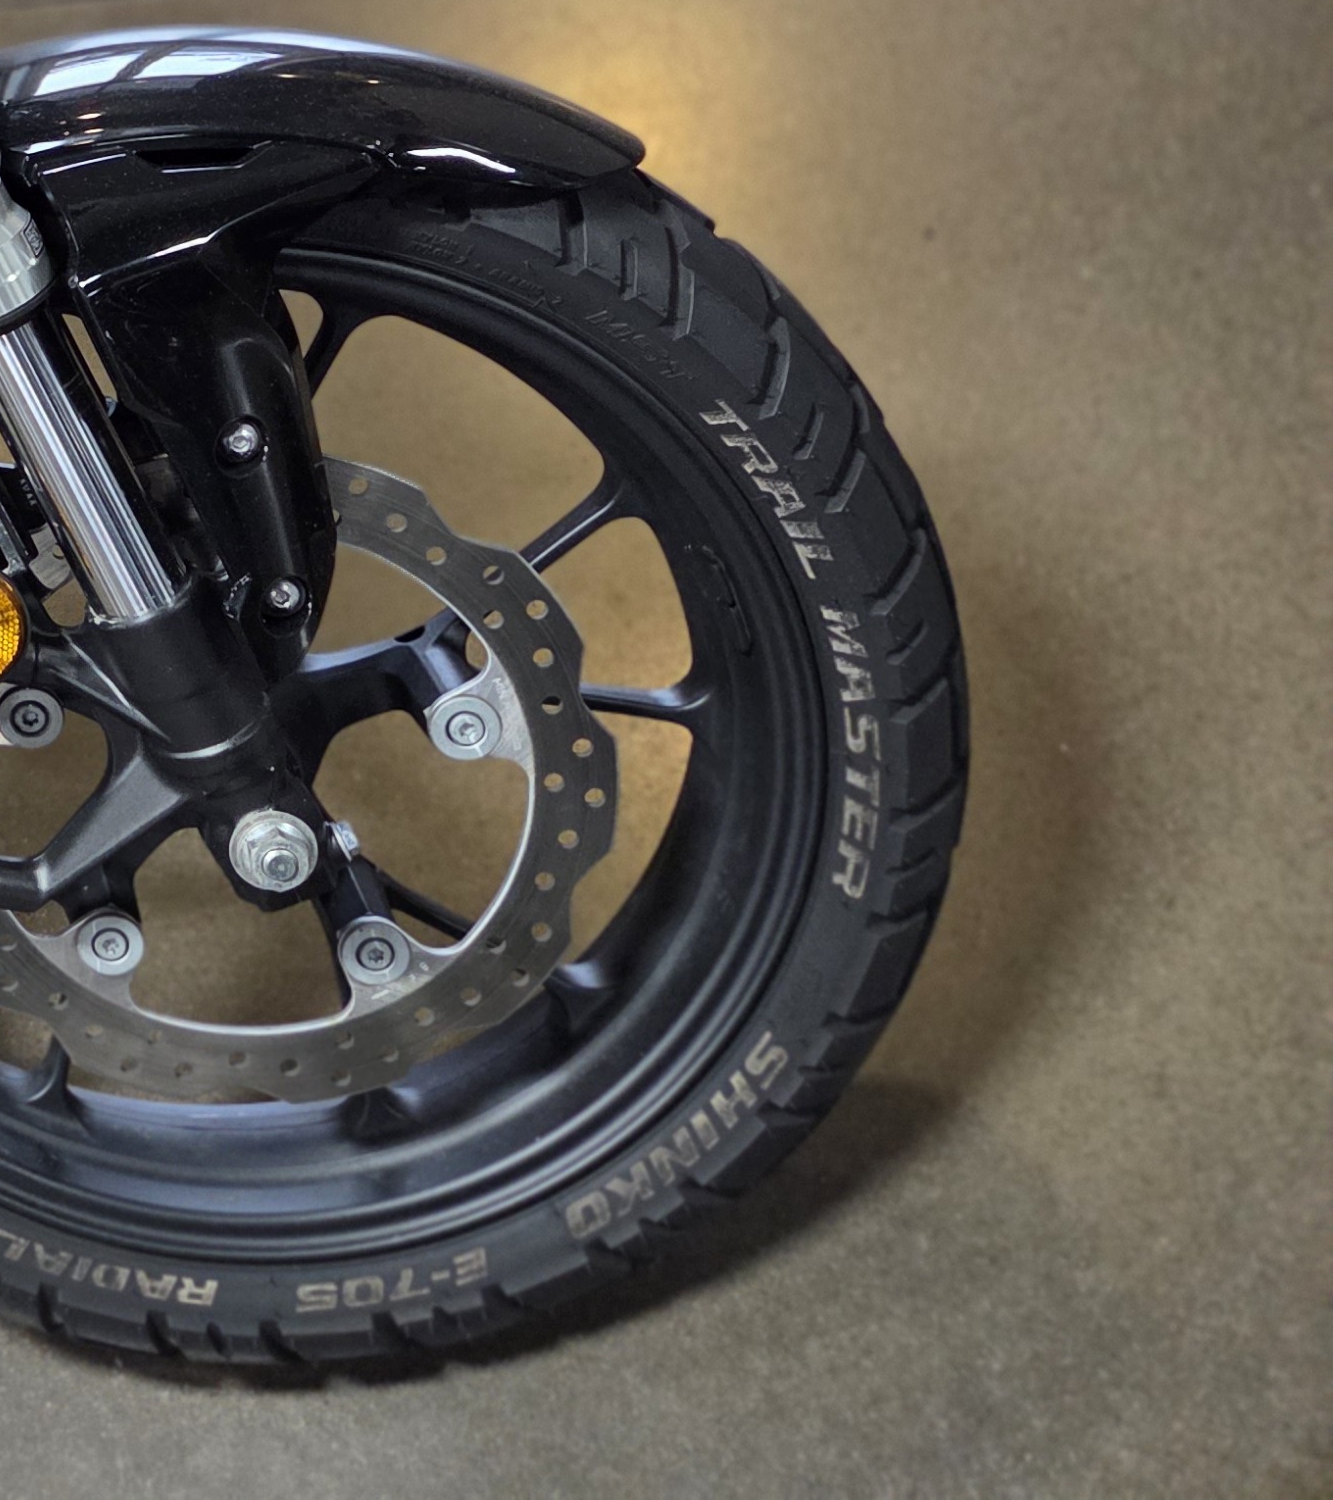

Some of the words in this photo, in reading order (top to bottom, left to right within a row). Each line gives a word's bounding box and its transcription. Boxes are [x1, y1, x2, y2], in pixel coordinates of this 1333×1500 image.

[699, 400, 833, 580] TRAIL
[820, 605, 882, 899] MASTER
[565, 1030, 788, 1239] SHINKO
[296, 1246, 488, 1313] E-705
